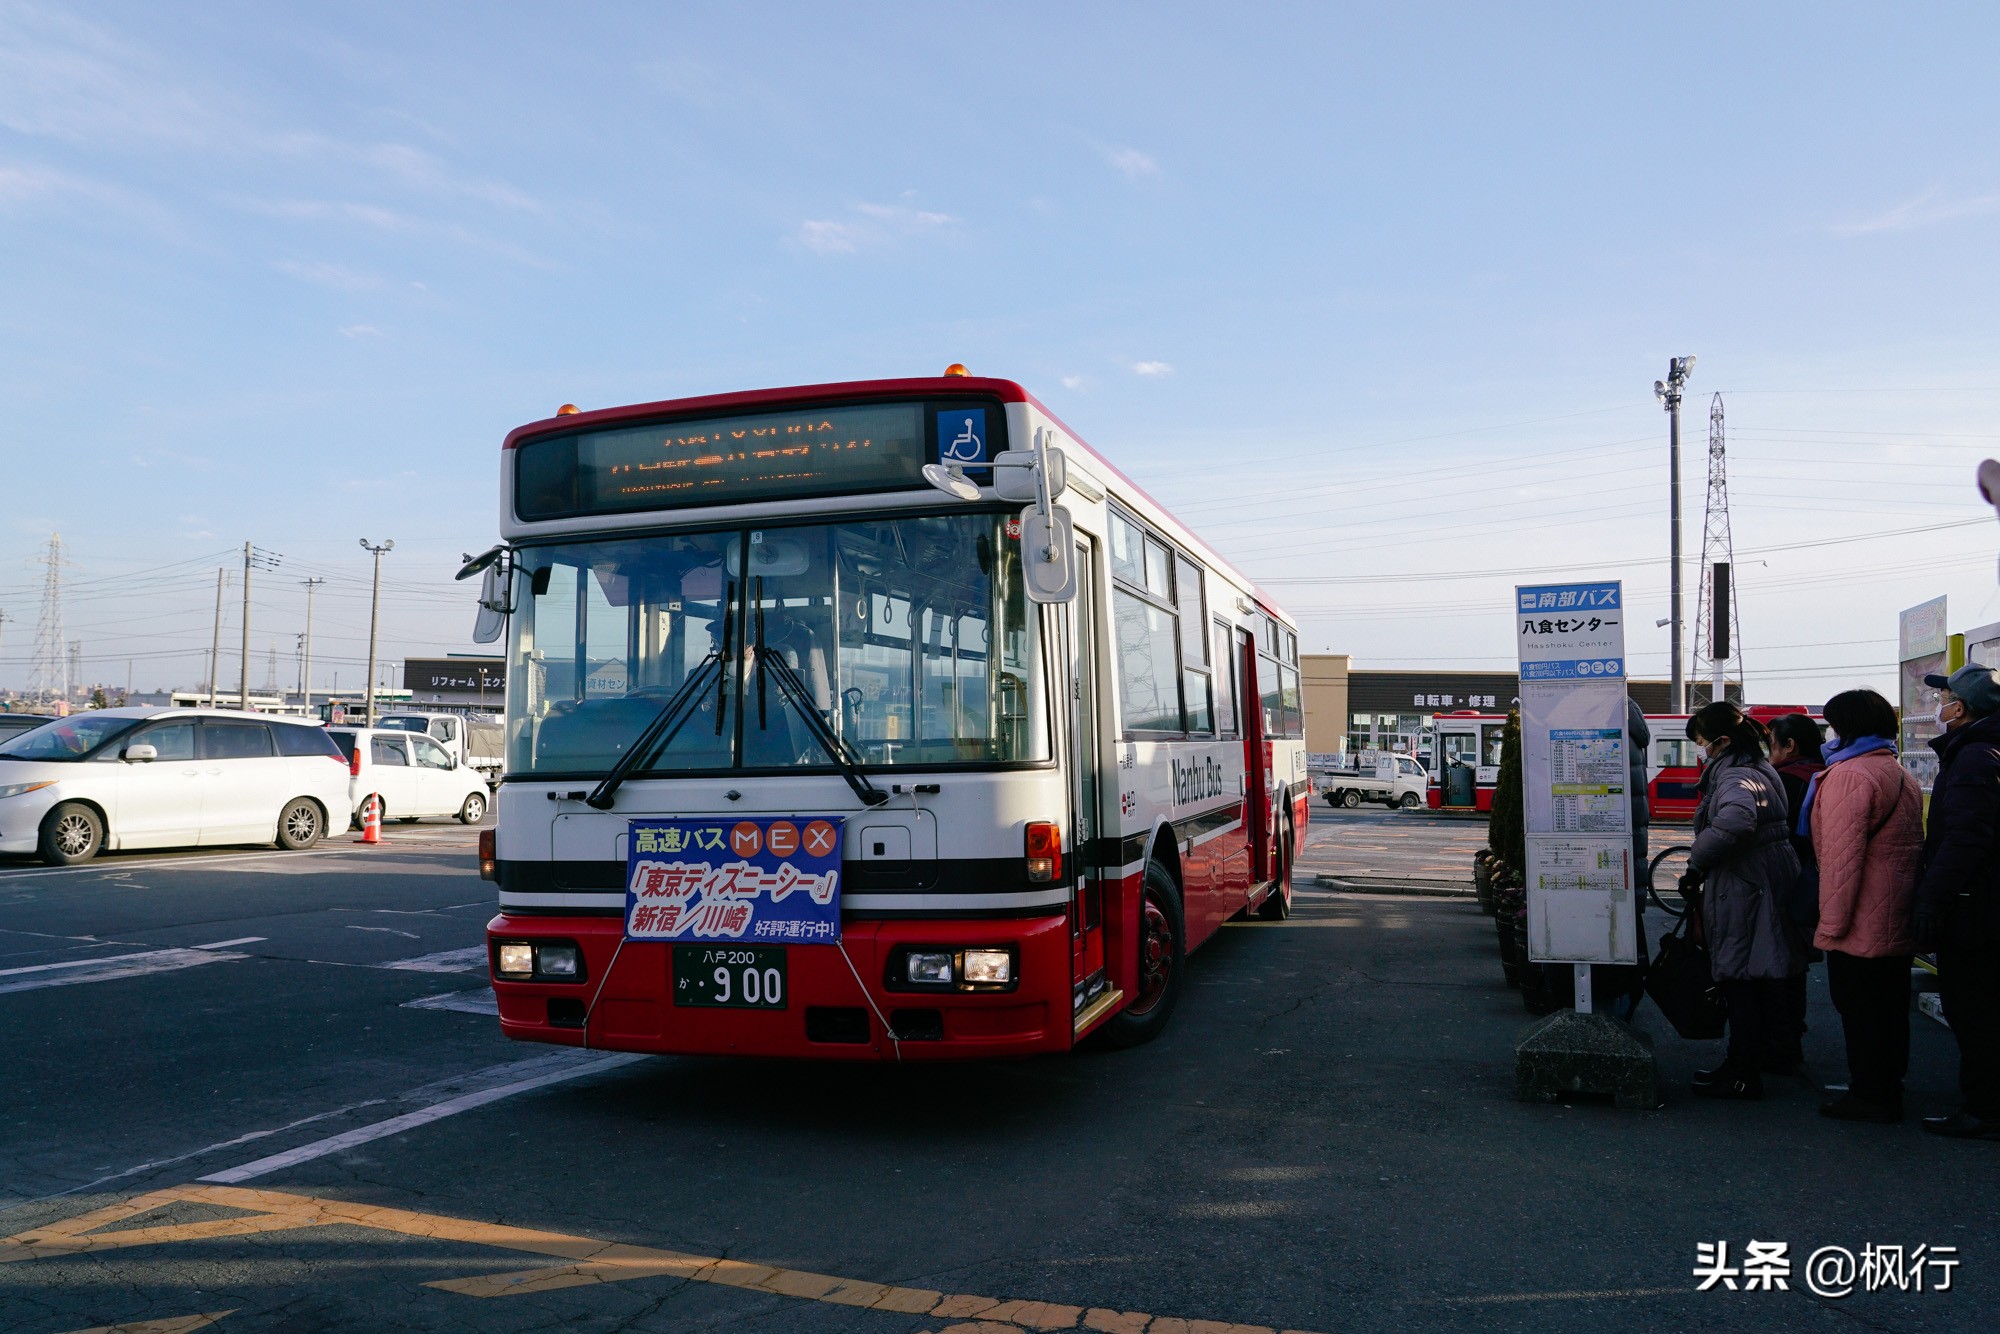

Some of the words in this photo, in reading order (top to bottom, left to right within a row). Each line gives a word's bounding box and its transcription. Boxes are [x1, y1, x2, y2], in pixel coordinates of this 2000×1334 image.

[1538, 588, 1617, 608] 南部バス
[1522, 617, 1619, 635] 八食センター
[1578, 640, 1613, 648] Center
[1580, 663, 1616, 672] MEX
[431, 676, 476, 687] リフォーム
[1414, 694, 1495, 707] 自転車・修理
[1172, 756, 1205, 808] Nanbu
[1206, 756, 1222, 798] Bus
[635, 827, 726, 853] 高速バス
[735, 828, 831, 849] MEX
[679, 977, 690, 990] か
